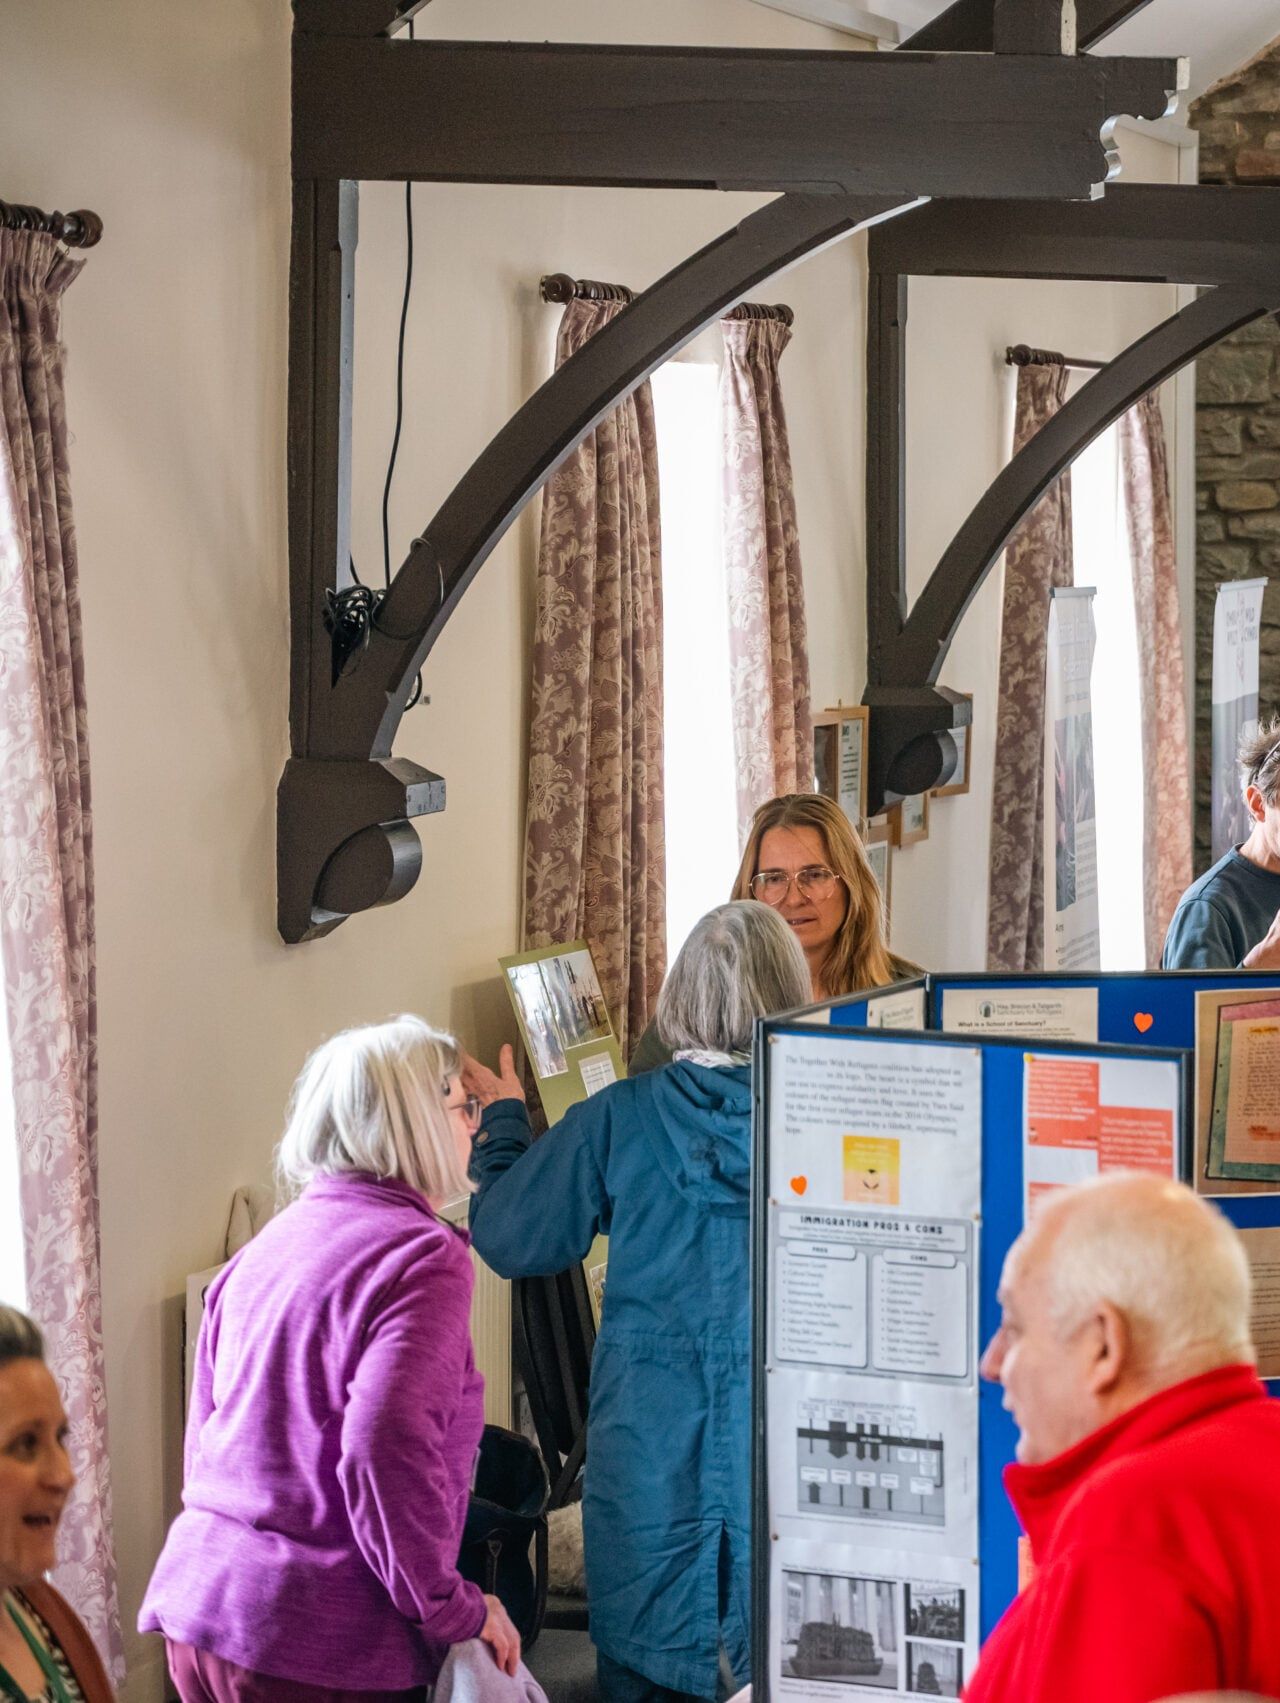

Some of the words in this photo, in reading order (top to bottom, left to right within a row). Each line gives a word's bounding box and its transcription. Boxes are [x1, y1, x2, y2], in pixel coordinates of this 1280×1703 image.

[800, 1215, 868, 1228] IMMIGRATION
[873, 1221, 899, 1232] PROS
[915, 1225, 943, 1235] CONS
